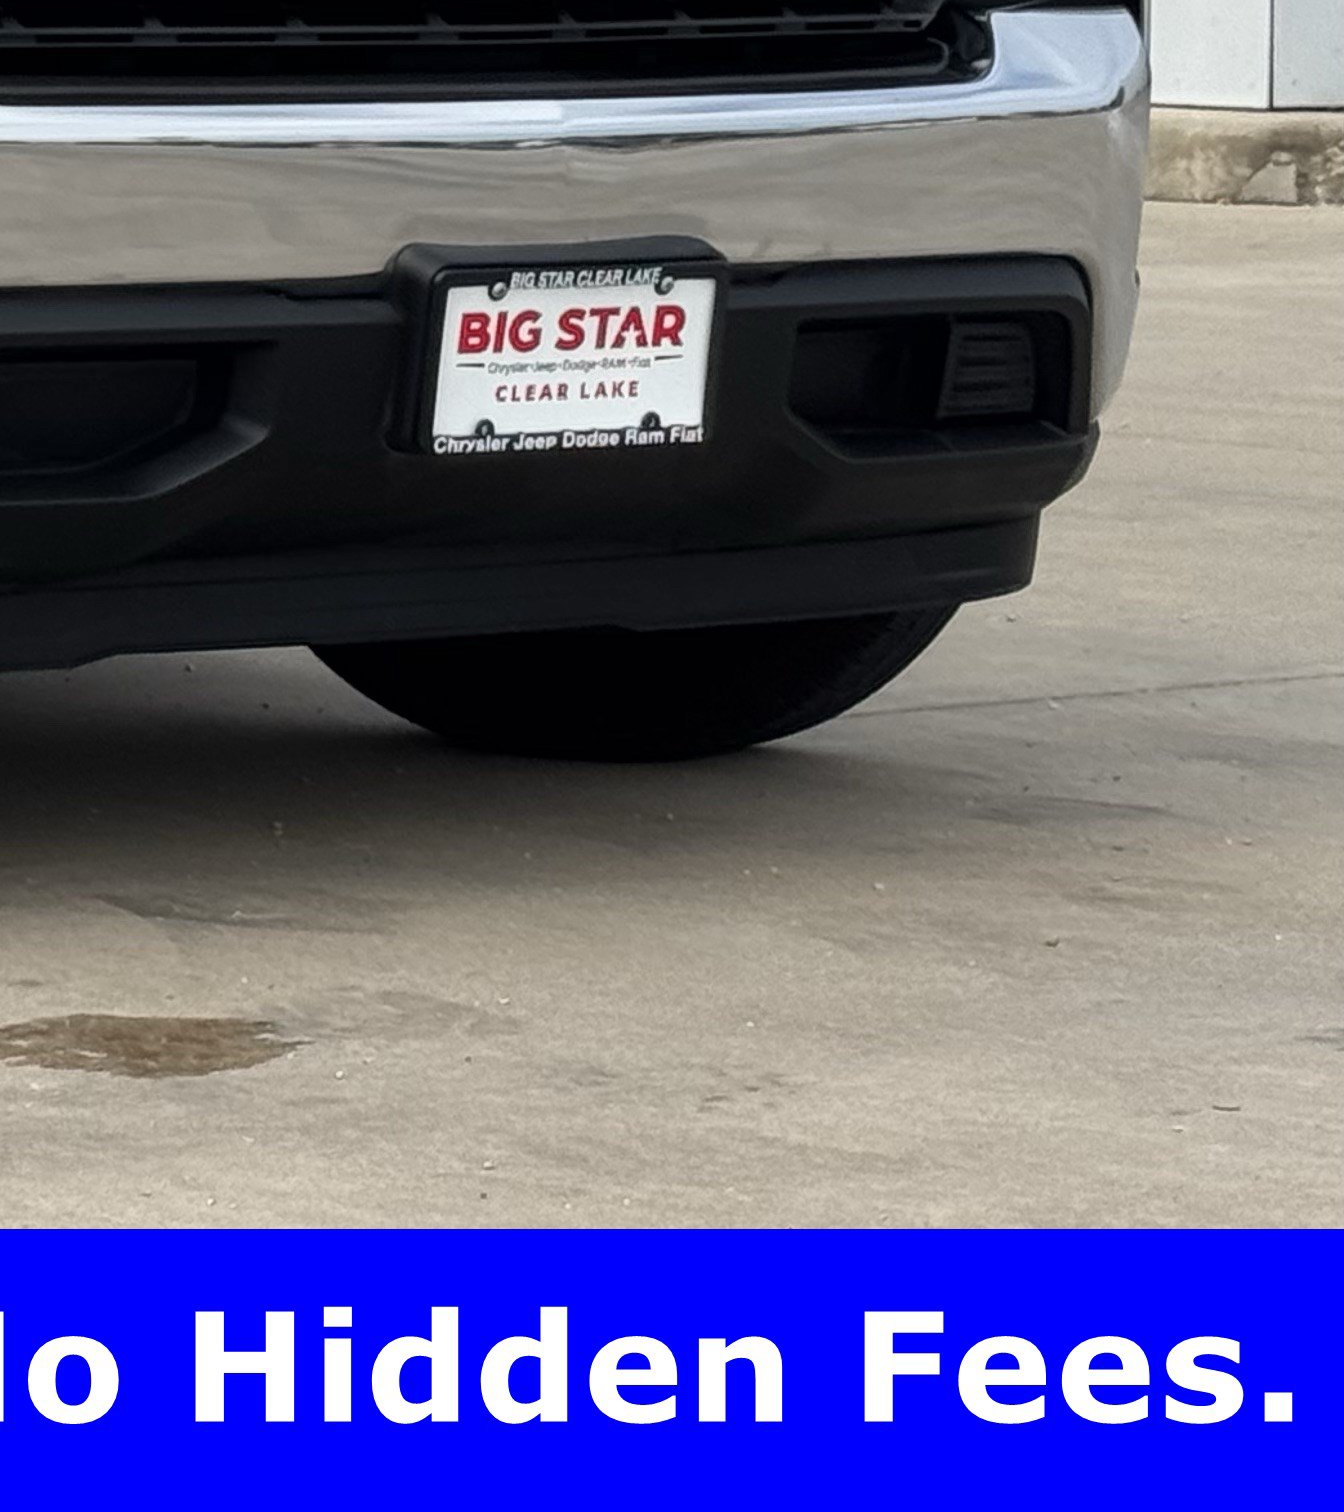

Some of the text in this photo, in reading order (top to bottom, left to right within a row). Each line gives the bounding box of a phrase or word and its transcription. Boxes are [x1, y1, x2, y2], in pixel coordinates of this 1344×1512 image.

[511, 266, 663, 289] BIG STAR CLEAR LAKE
[457, 304, 686, 355] BIG STAR
[495, 379, 640, 402] CLEAR LAKE
[433, 425, 705, 454] Chrysler Jeep Dodge Ram Fiat
